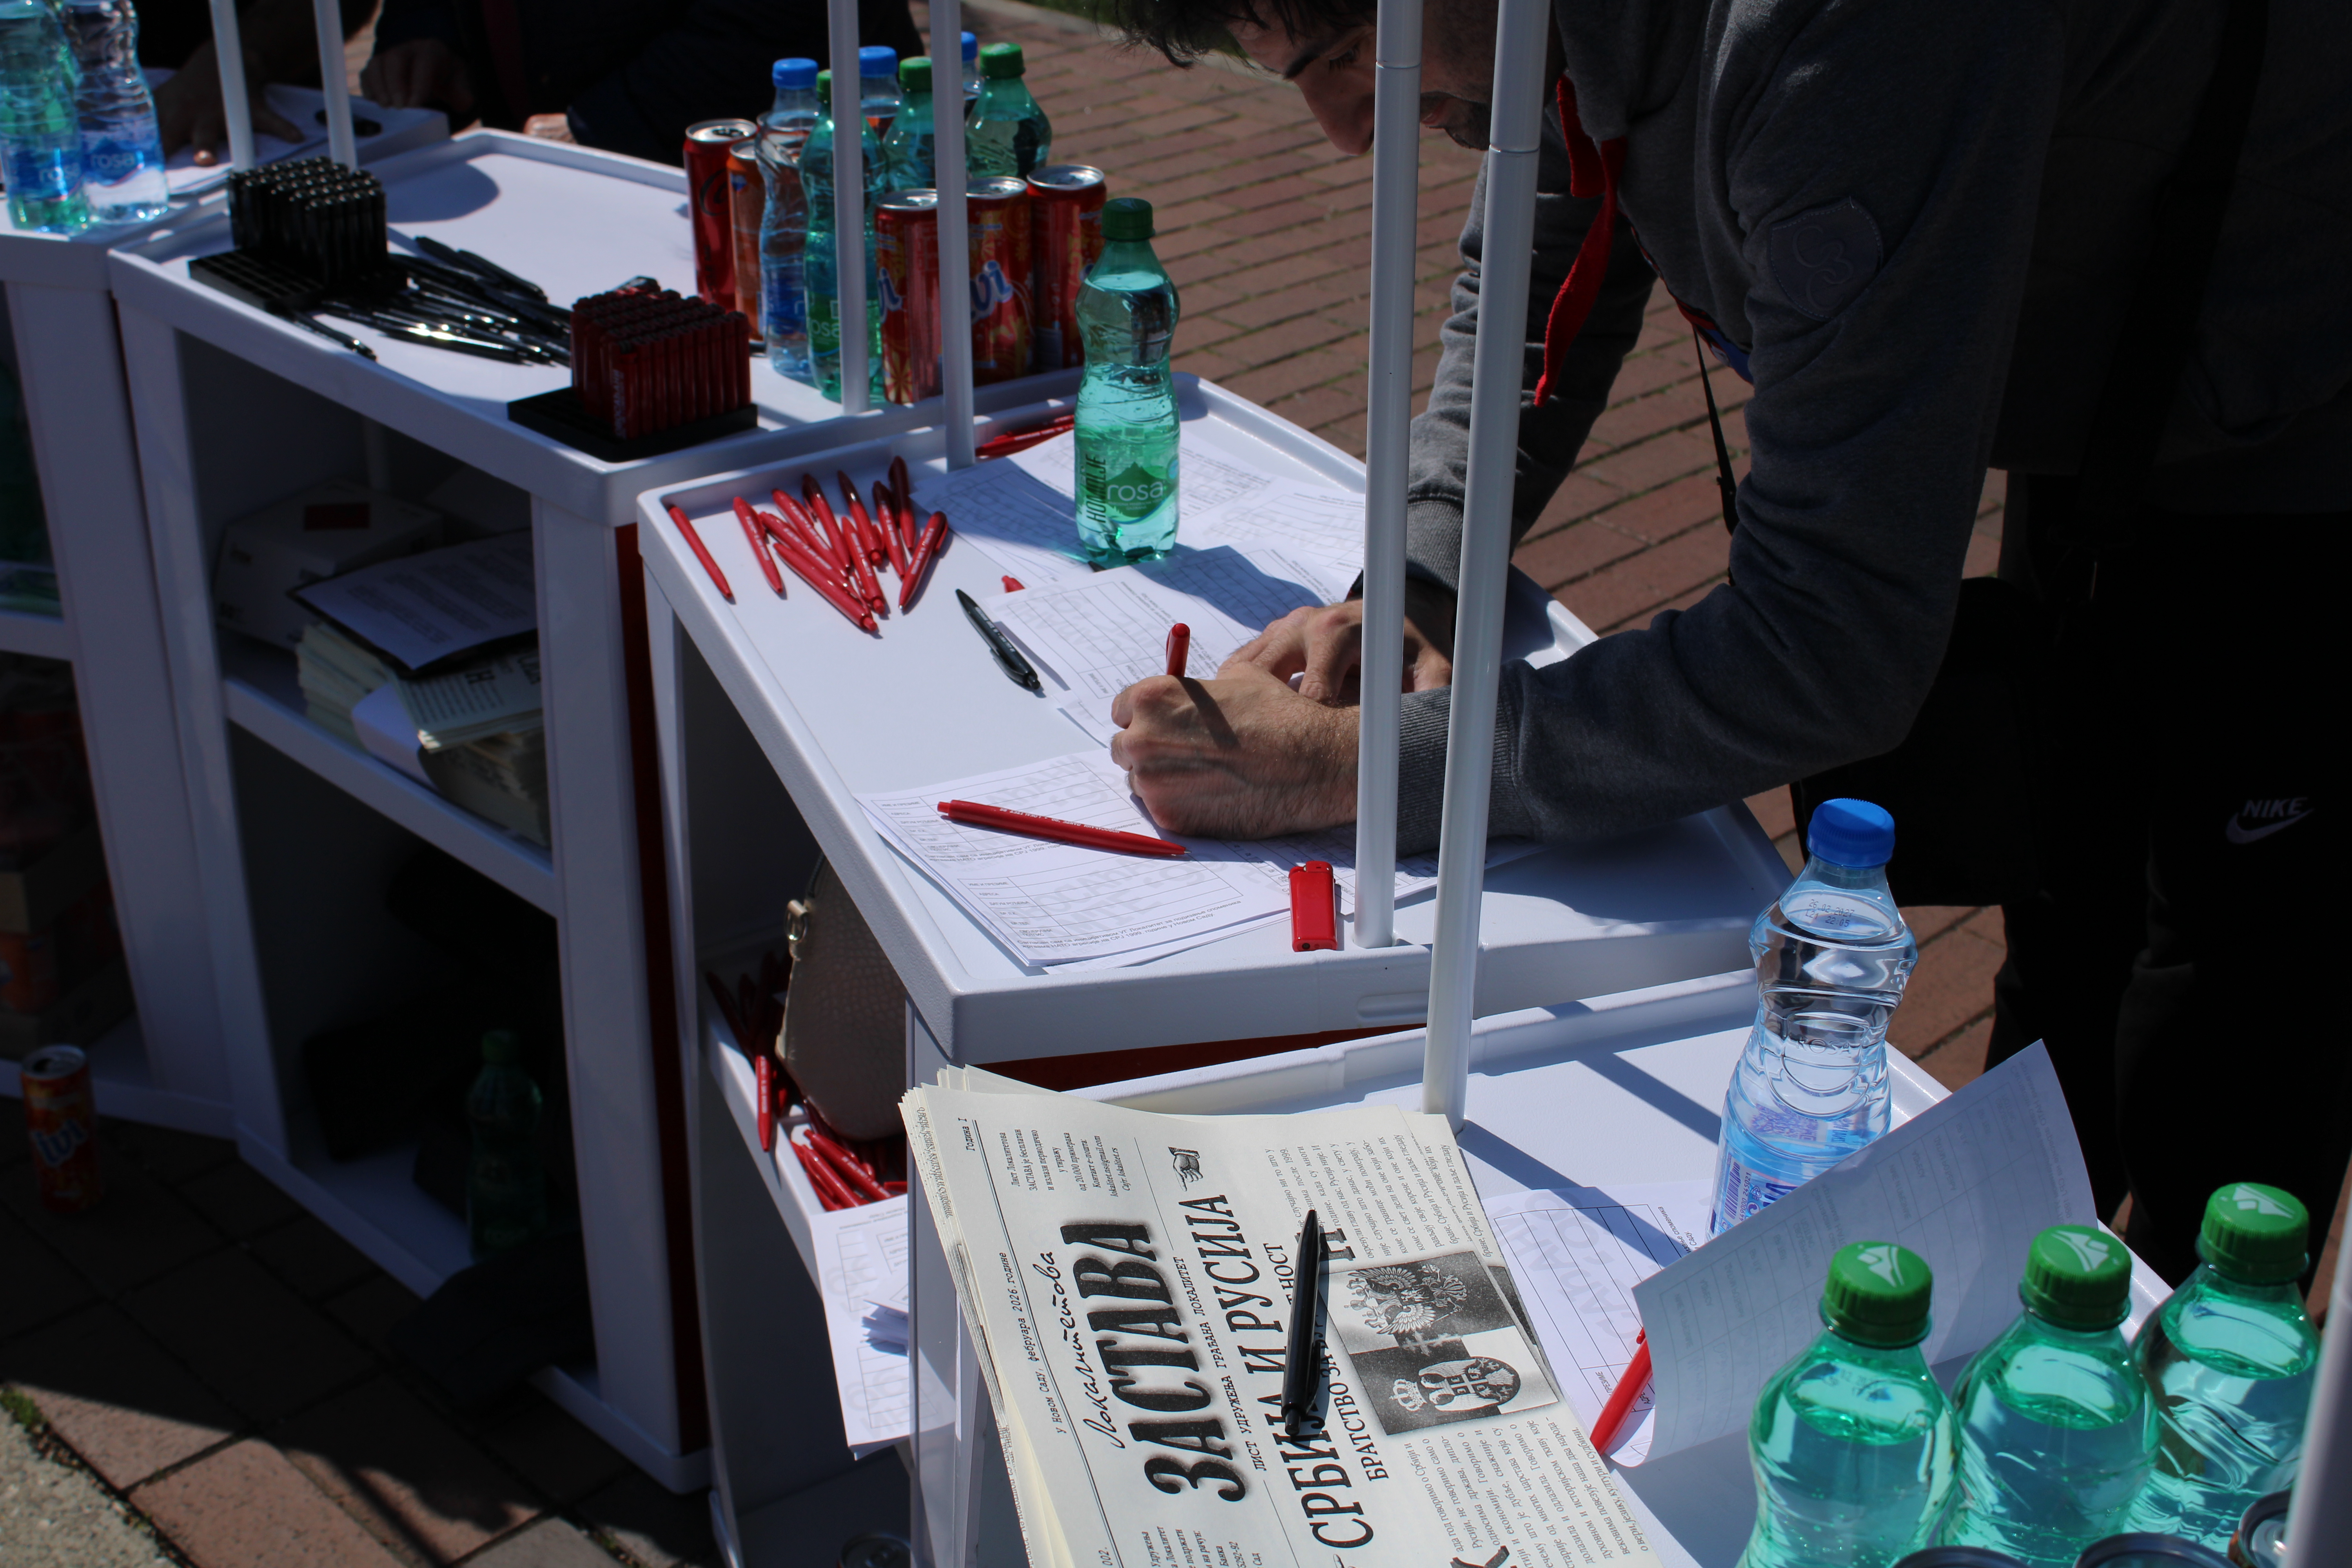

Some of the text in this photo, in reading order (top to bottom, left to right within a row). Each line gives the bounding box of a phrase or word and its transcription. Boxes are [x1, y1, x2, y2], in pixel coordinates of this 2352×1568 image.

[90, 152, 134, 169] rosa
[810, 319, 840, 338] osa
[1085, 454, 1106, 523] HOMOLJE
[1107, 481, 1163, 502] rosa
[2241, 796, 2308, 818] NIKE
[1070, 939, 1102, 948] агресије
[1108, 933, 1126, 942] СРЈ
[1143, 924, 1169, 935] године
[1171, 916, 1197, 927] Новом
[1072, 931, 1120, 943] иницијативом
[1127, 920, 1165, 934] Локалитет
[1172, 909, 1207, 923] подизање
[1205, 899, 1243, 914] споменика
[961, 1125, 976, 1152] Година
[1014, 1128, 1029, 1158] бесплатан
[1030, 1129, 1048, 1165] периодично
[1377, 1136, 1387, 1145] их
[1392, 1134, 1411, 1157] гледају
[998, 1131, 1021, 1187] Лист Локалитетова
[1051, 1146, 1066, 1169] тиражу
[1063, 1132, 1088, 1192] од 20.000 примерака
[1093, 1135, 1119, 1198] lokalitet.ns@gmail.com
[1111, 1146, 1127, 1178] lokalitet.rs
[1332, 1149, 1347, 1167] свету
[1381, 1146, 1395, 1161] који
[1405, 1156, 1421, 1173] даље
[1022, 1164, 1038, 1192] ЗАСТАВА
[1040, 1164, 1054, 1186] излази
[1088, 1163, 1102, 1189] Контакт
[1390, 1161, 1402, 1174] оне
[1296, 1145, 1342, 1227] године, када су многи
[1345, 1174, 1361, 1195] данас,
[1401, 1182, 1419, 1205] корене
[1416, 1177, 1434, 1199] Русија
[1743, 1172, 1752, 1196] 245021
[1356, 1196, 1368, 1211] што
[1413, 1206, 1428, 1223] своје
[1430, 1203, 1448, 1225] Србија
[1363, 1212, 1384, 1241] случајно
[1423, 1224, 1445, 1248] рављају
[1443, 1223, 1461, 1245] бране,
[1658, 1206, 1684, 1240] споменика
[1378, 1242, 1392, 1257] није
[1178, 1194, 1284, 1333] РУСИЈА
[1017, 1317, 1040, 1362] фебруара
[1032, 1251, 1126, 1450] Локалитетова
[1059, 1223, 1247, 1503] ЗАСТАВА
[1172, 1256, 1268, 1472] ЛИСТ УДРУЖЕЊА ГРАЂАНА ЛОКАЛИТЕТ
[1236, 1345, 1299, 1375] И
[1034, 1368, 1050, 1393] Саду,
[1044, 1396, 1063, 1424] Новом
[1321, 1381, 1390, 1482] БРАТСТВО
[1526, 1420, 1541, 1436] које
[1547, 1421, 1568, 1448] народа
[1514, 1432, 1541, 1471] Говоримо
[1536, 1437, 1554, 1458] ткиву
[1563, 1447, 1579, 1461] два
[1572, 1426, 1595, 1459] судбини.
[1406, 1449, 1427, 1477] Србији
[1571, 1461, 1589, 1483] наша
[1441, 1435, 1501, 1546] односима држава, дипло-
[1538, 1472, 1564, 1513] одлазила.
[1550, 1459, 1583, 1509] историјском
[1593, 1465, 1619, 1497] култури
[1424, 1483, 1449, 1522] говоримо
[1491, 1427, 1575, 1568] старије од многих царстава која су
[1583, 1483, 1608, 1516] повезује
[1612, 1496, 1637, 1523] језику,
[1443, 1521, 1457, 1537] год
[1584, 1519, 1613, 1559] духовном
[1603, 1516, 1631, 1555] вековима
[1628, 1523, 1646, 1545] вери,
[1156, 1525, 1177, 1564] Локалитет
[1174, 1528, 1195, 1565] подржати
[1215, 1545, 1230, 1568] Банка
[1228, 1541, 1247, 1568] 5292-92
[1566, 1524, 1595, 1564] долазила
[1201, 1553, 1212, 1564] на
[1251, 1552, 1263, 1566] Сад
